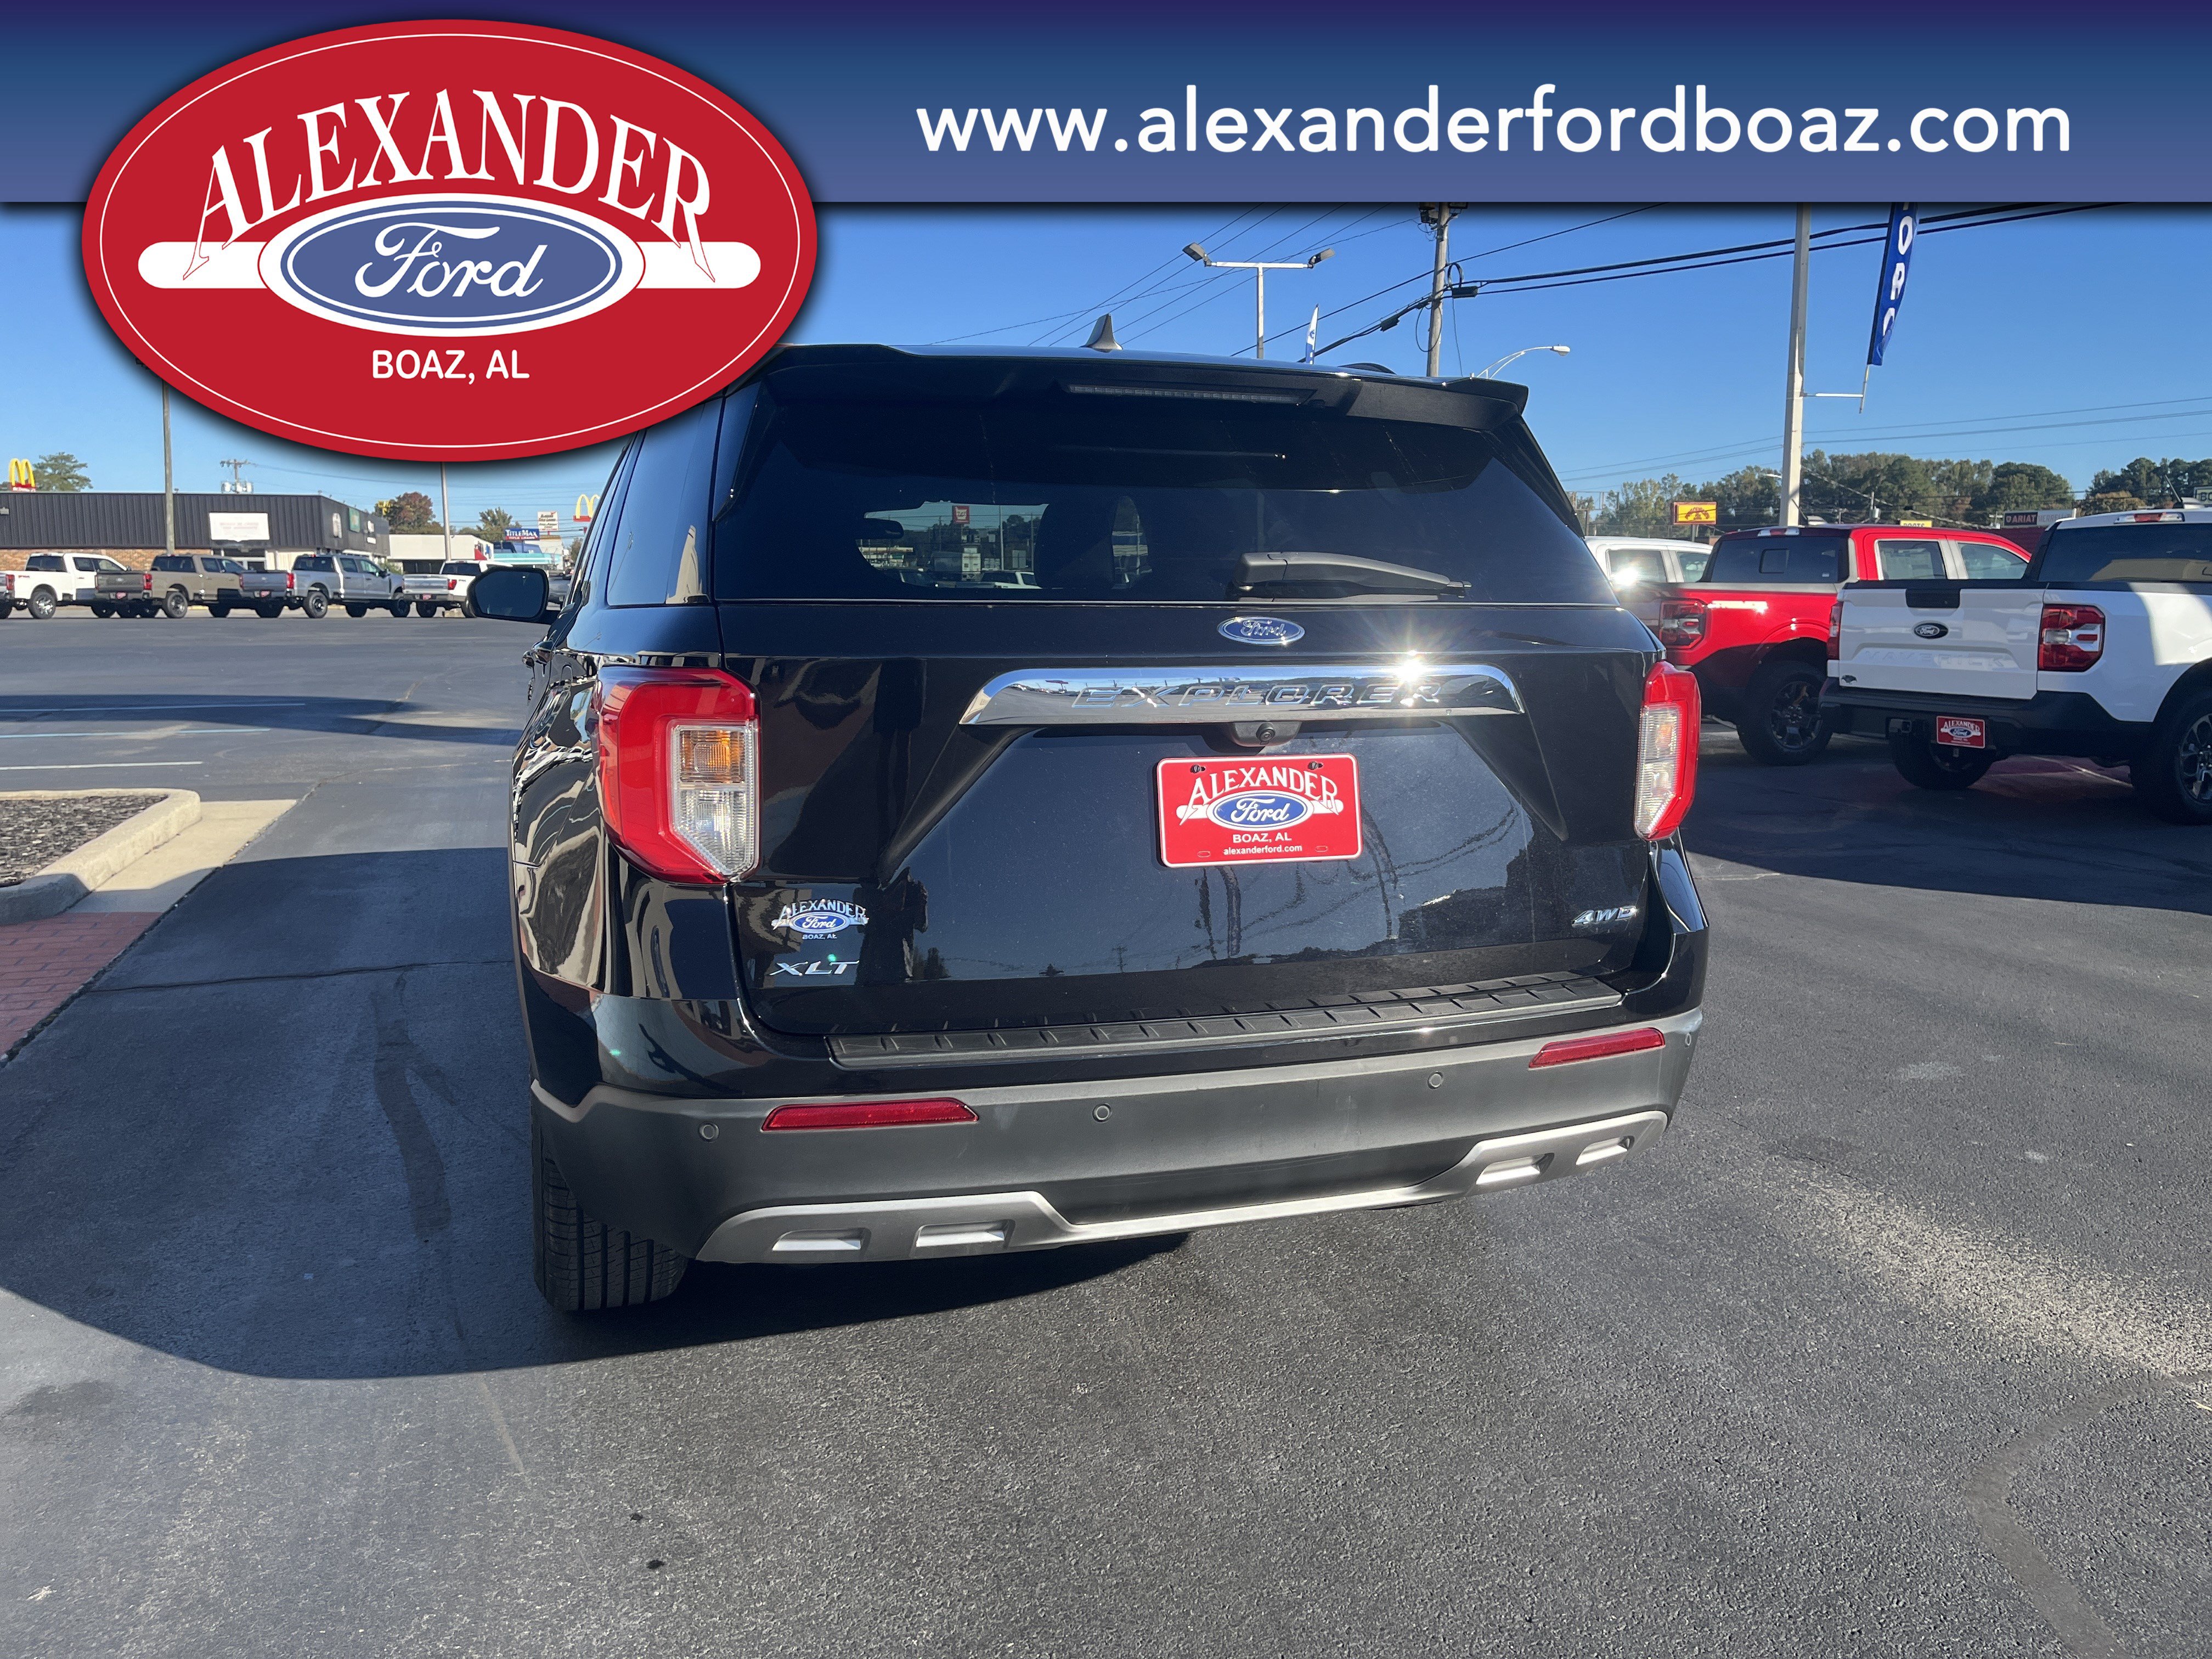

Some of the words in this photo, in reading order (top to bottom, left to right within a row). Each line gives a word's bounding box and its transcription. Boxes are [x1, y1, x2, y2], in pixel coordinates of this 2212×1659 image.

[2012, 514, 2037, 523] ARIAT
[1240, 619, 1287, 636] Ford
[1071, 684, 1441, 708] EXPLORER
[1179, 766, 1339, 826] ALEXANDER
[1230, 797, 1291, 823] Ford
[1232, 833, 1272, 843] BOAZ,
[1274, 832, 1292, 842] AL
[1223, 844, 1302, 855] alexanderford.com
[772, 899, 870, 930] ALEXANDER
[802, 915, 836, 929] Ford
[1571, 905, 1638, 927] AWD
[769, 960, 860, 976] XLT
